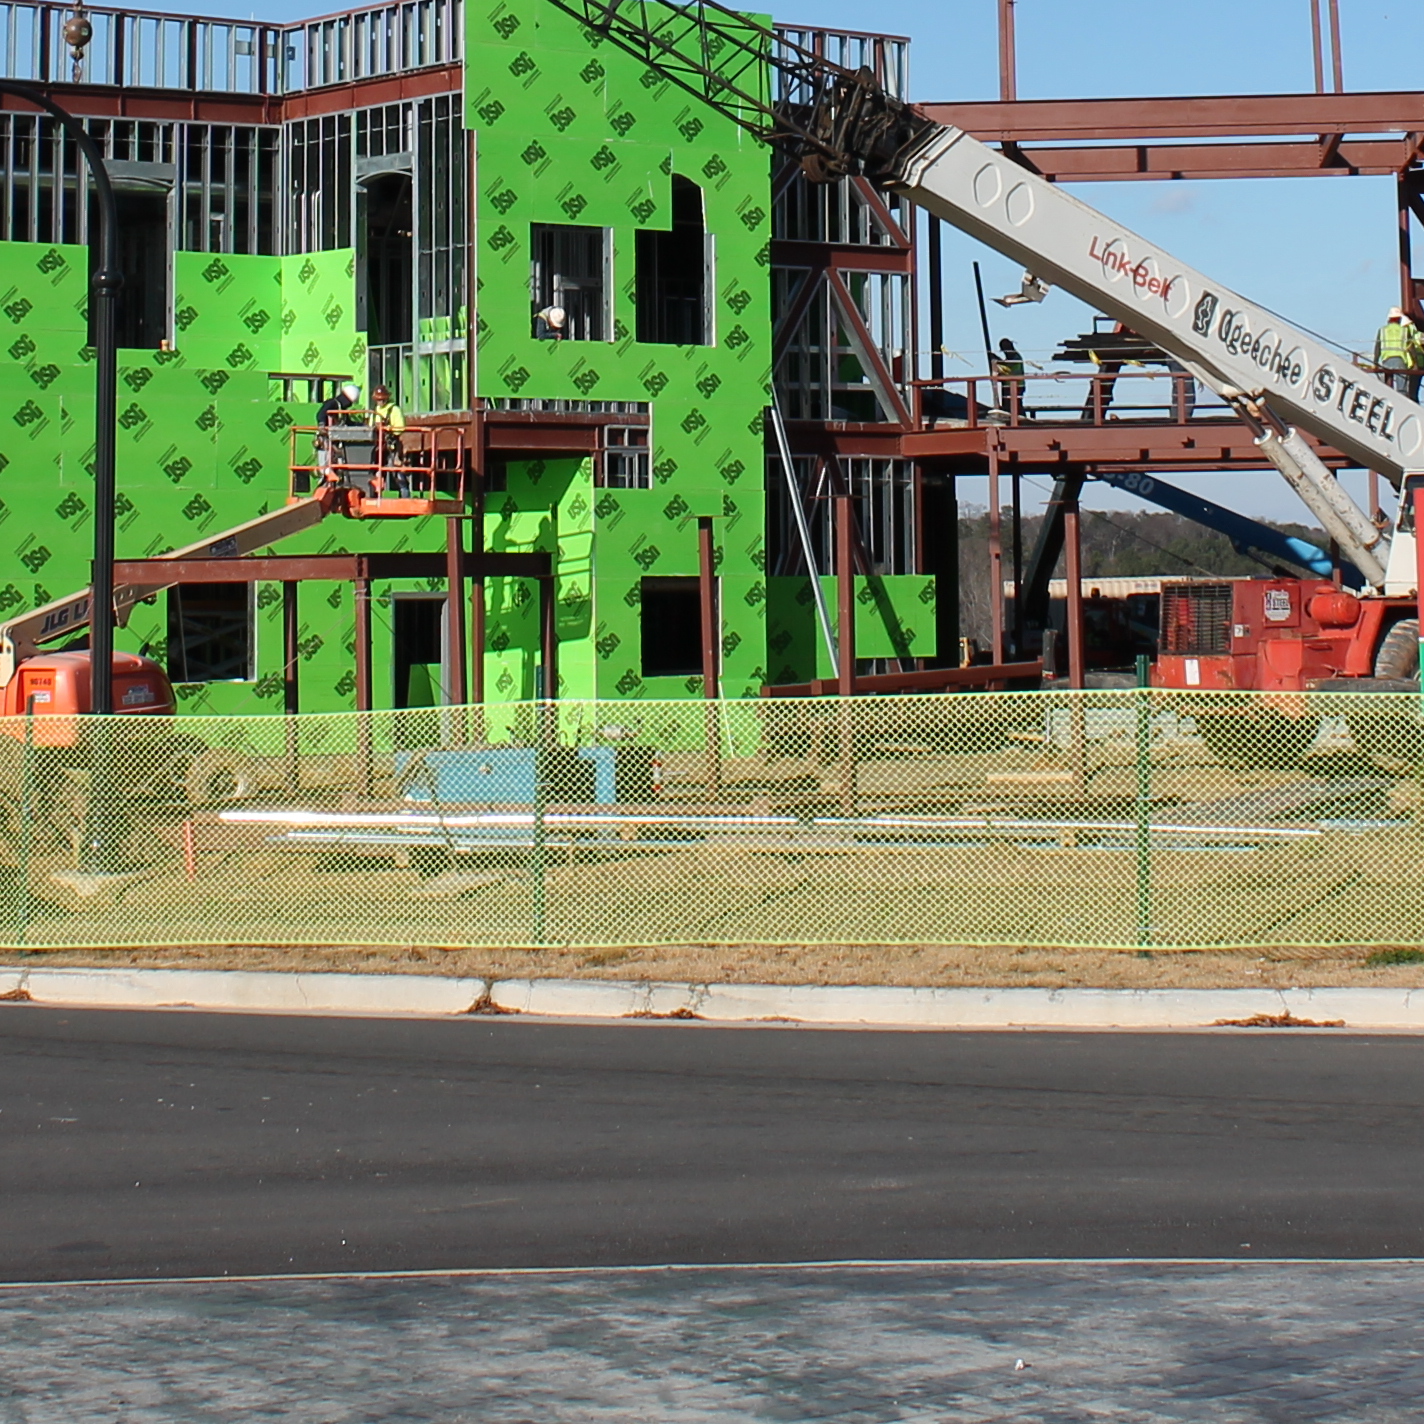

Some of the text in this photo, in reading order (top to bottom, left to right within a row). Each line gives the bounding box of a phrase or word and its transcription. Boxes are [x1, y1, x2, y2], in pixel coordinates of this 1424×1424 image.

[492, 14, 521, 40] USG
[509, 52, 536, 78] USG
[580, 58, 606, 84] USG
[477, 99, 505, 127] USG
[549, 106, 576, 132] USG
[608, 111, 636, 137] USG
[677, 116, 704, 143] USG
[521, 140, 547, 166] USG
[590, 145, 616, 171] USG
[702, 154, 727, 180] USG
[490, 189, 518, 216] USG
[559, 194, 588, 219] USG
[631, 198, 656, 225] USG
[738, 206, 766, 231] USG
[487, 225, 514, 252] USG
[37, 248, 66, 274] USG
[202, 258, 229, 283] USG
[1089, 235, 1174, 301] Link-Belt
[4, 298, 33, 325] USG
[725, 290, 751, 315] USG
[243, 309, 271, 334] USG
[8, 334, 36, 359] USG
[724, 324, 749, 350] USG
[226, 343, 252, 368] USG
[30, 364, 61, 390] USG
[124, 367, 154, 392] USG
[202, 370, 230, 395] USG
[504, 368, 530, 393] USG
[573, 369, 600, 395] USG
[642, 371, 669, 398] USG
[696, 373, 722, 400] USG
[13, 399, 44, 428] USG
[1313, 361, 1396, 442] STEEL
[118, 402, 147, 430] USG
[266, 407, 293, 432] USG
[680, 408, 706, 434] USG
[163, 457, 192, 484] USG
[233, 458, 263, 484] USG
[652, 458, 679, 485] USG
[719, 459, 745, 486] USG
[56, 492, 86, 520] USG
[182, 493, 212, 521] USG
[594, 493, 620, 520] USG
[663, 495, 689, 521] USG
[21, 545, 51, 573] USG
[634, 546, 660, 572] USG
[40, 607, 69, 634] JLG
[595, 634, 621, 661] USG
[616, 670, 642, 696] USG
